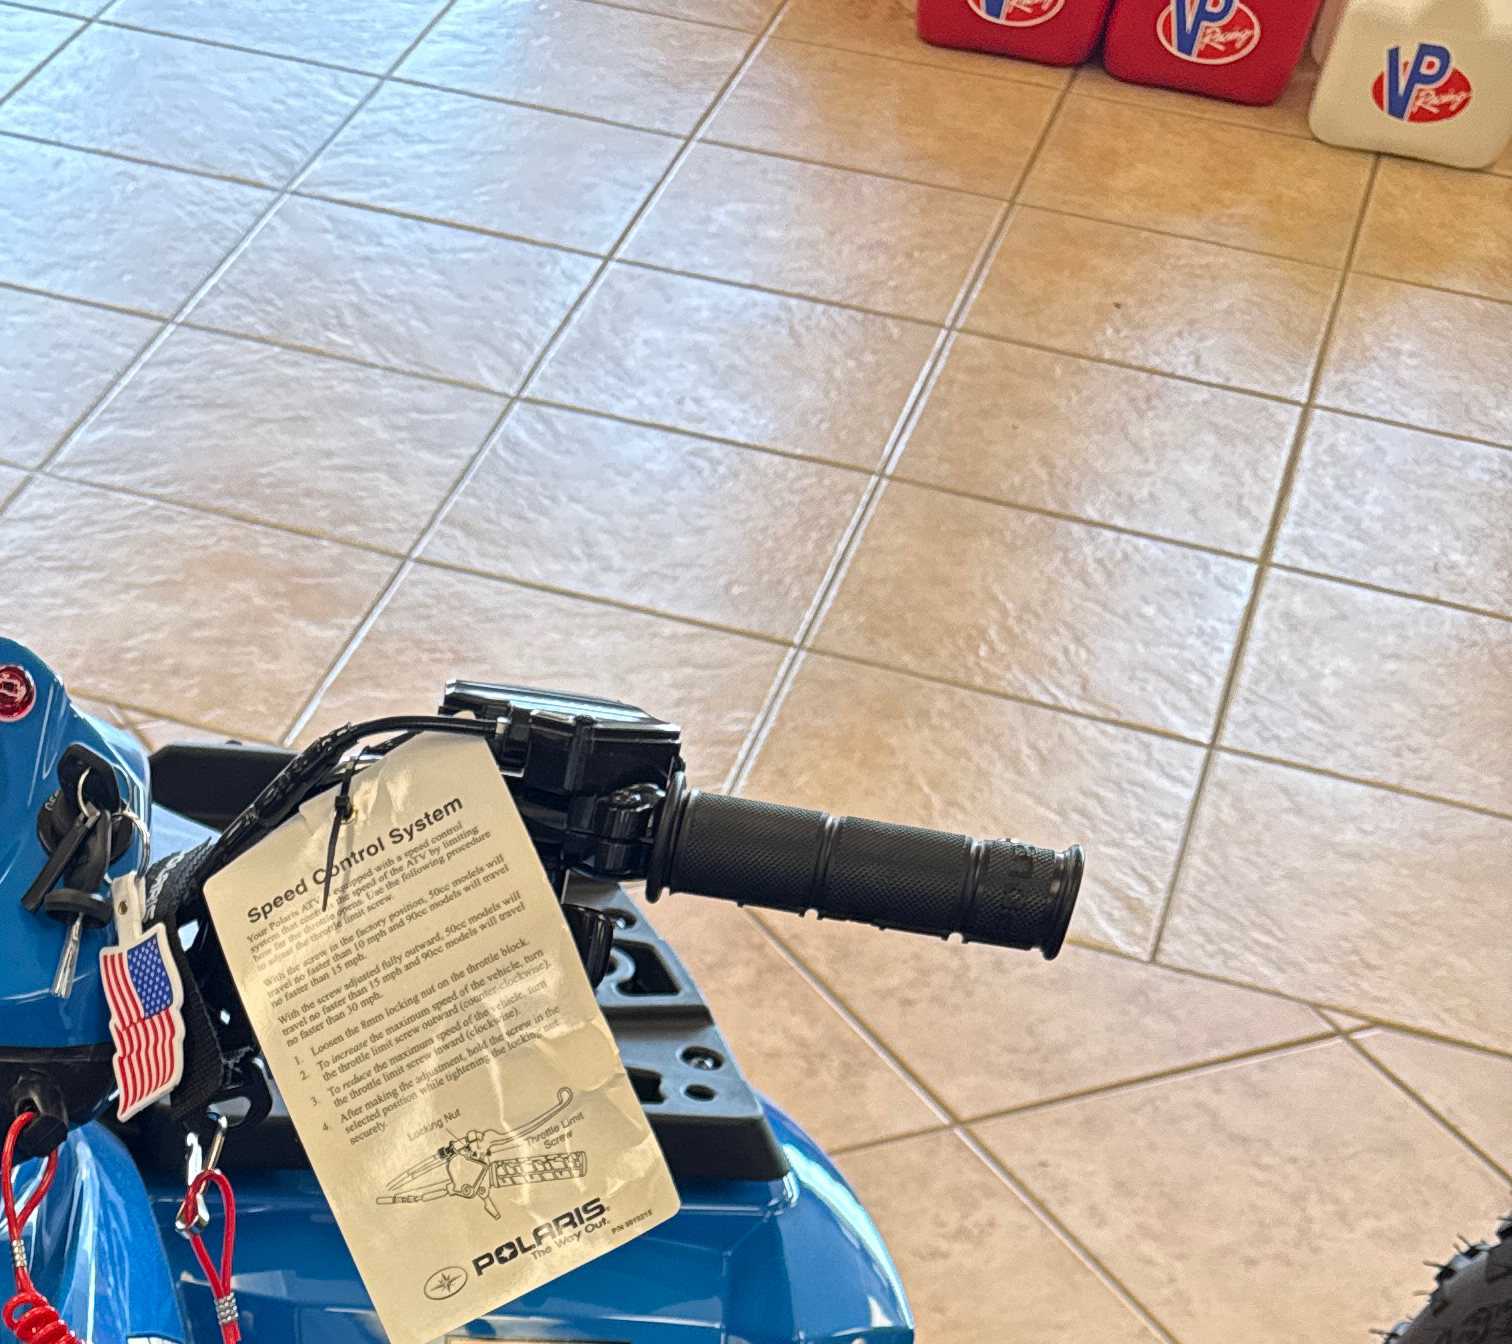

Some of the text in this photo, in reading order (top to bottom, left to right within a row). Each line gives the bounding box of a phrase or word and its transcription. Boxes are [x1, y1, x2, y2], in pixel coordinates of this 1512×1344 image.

[1202, 26, 1253, 50] Racing
[1386, 42, 1451, 120] VP
[1414, 88, 1472, 113] Racing
[247, 798, 464, 924] Speed Control System
[407, 1108, 461, 1142] Locking Nut
[525, 1112, 585, 1148] Throttle Limit
[543, 1130, 574, 1150] Screw
[472, 1197, 607, 1277] POLARIS
[531, 1244, 553, 1262] The
[554, 1230, 582, 1250] Way
